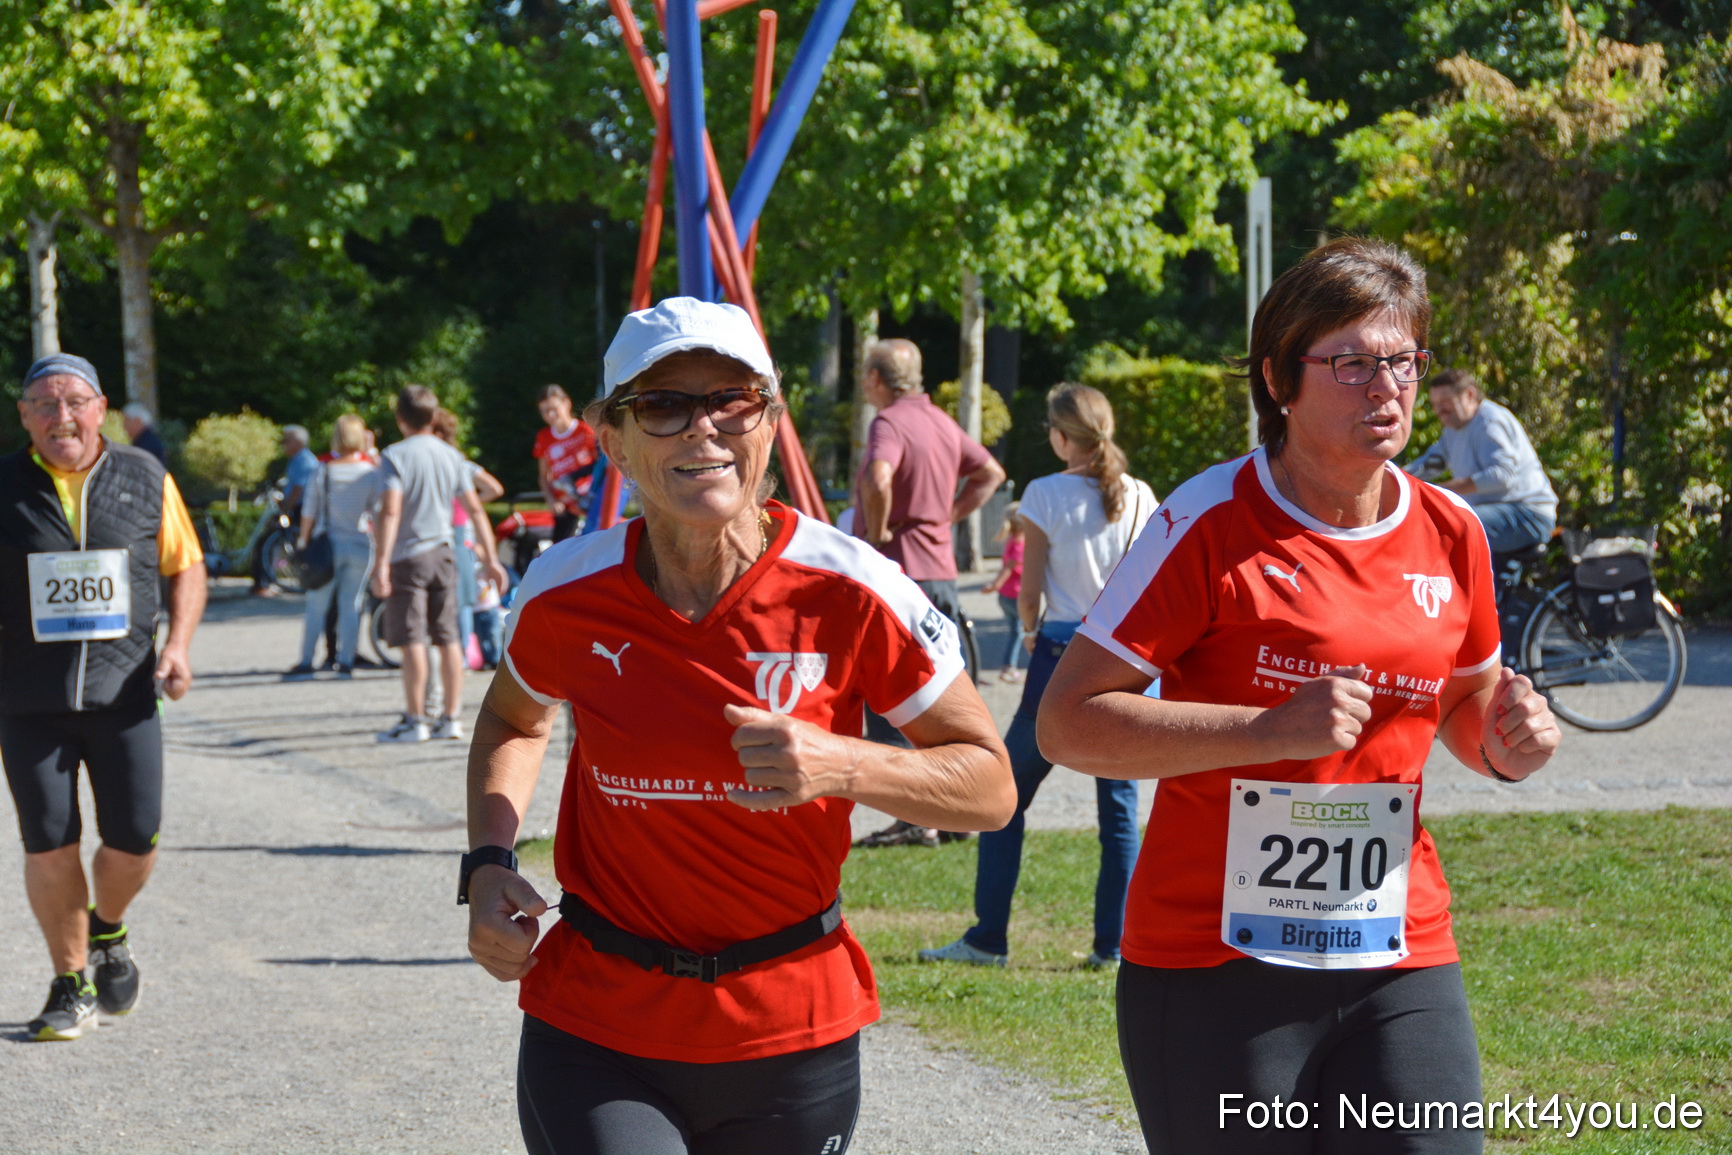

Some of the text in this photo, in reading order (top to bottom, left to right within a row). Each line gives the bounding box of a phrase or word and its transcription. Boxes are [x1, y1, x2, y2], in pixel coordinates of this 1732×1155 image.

[45, 576, 114, 604] 2360
[1257, 645, 1445, 695] ENGELHT & WALTER
[1251, 677, 1297, 694] Ambe
[1376, 687, 1393, 696] DAS
[592, 765, 696, 791] ENGELHARDT
[703, 780, 714, 792] &
[705, 793, 724, 802] DAS
[1291, 801, 1370, 821] BOCK
[1290, 820, 1317, 829] inspired
[1318, 821, 1326, 829] by
[1345, 821, 1371, 829] concepts
[1258, 834, 1388, 891] 2210
[1238, 875, 1246, 885] D
[1268, 898, 1363, 912] PARTL Neumarkt
[1281, 923, 1362, 953] Birgitta
